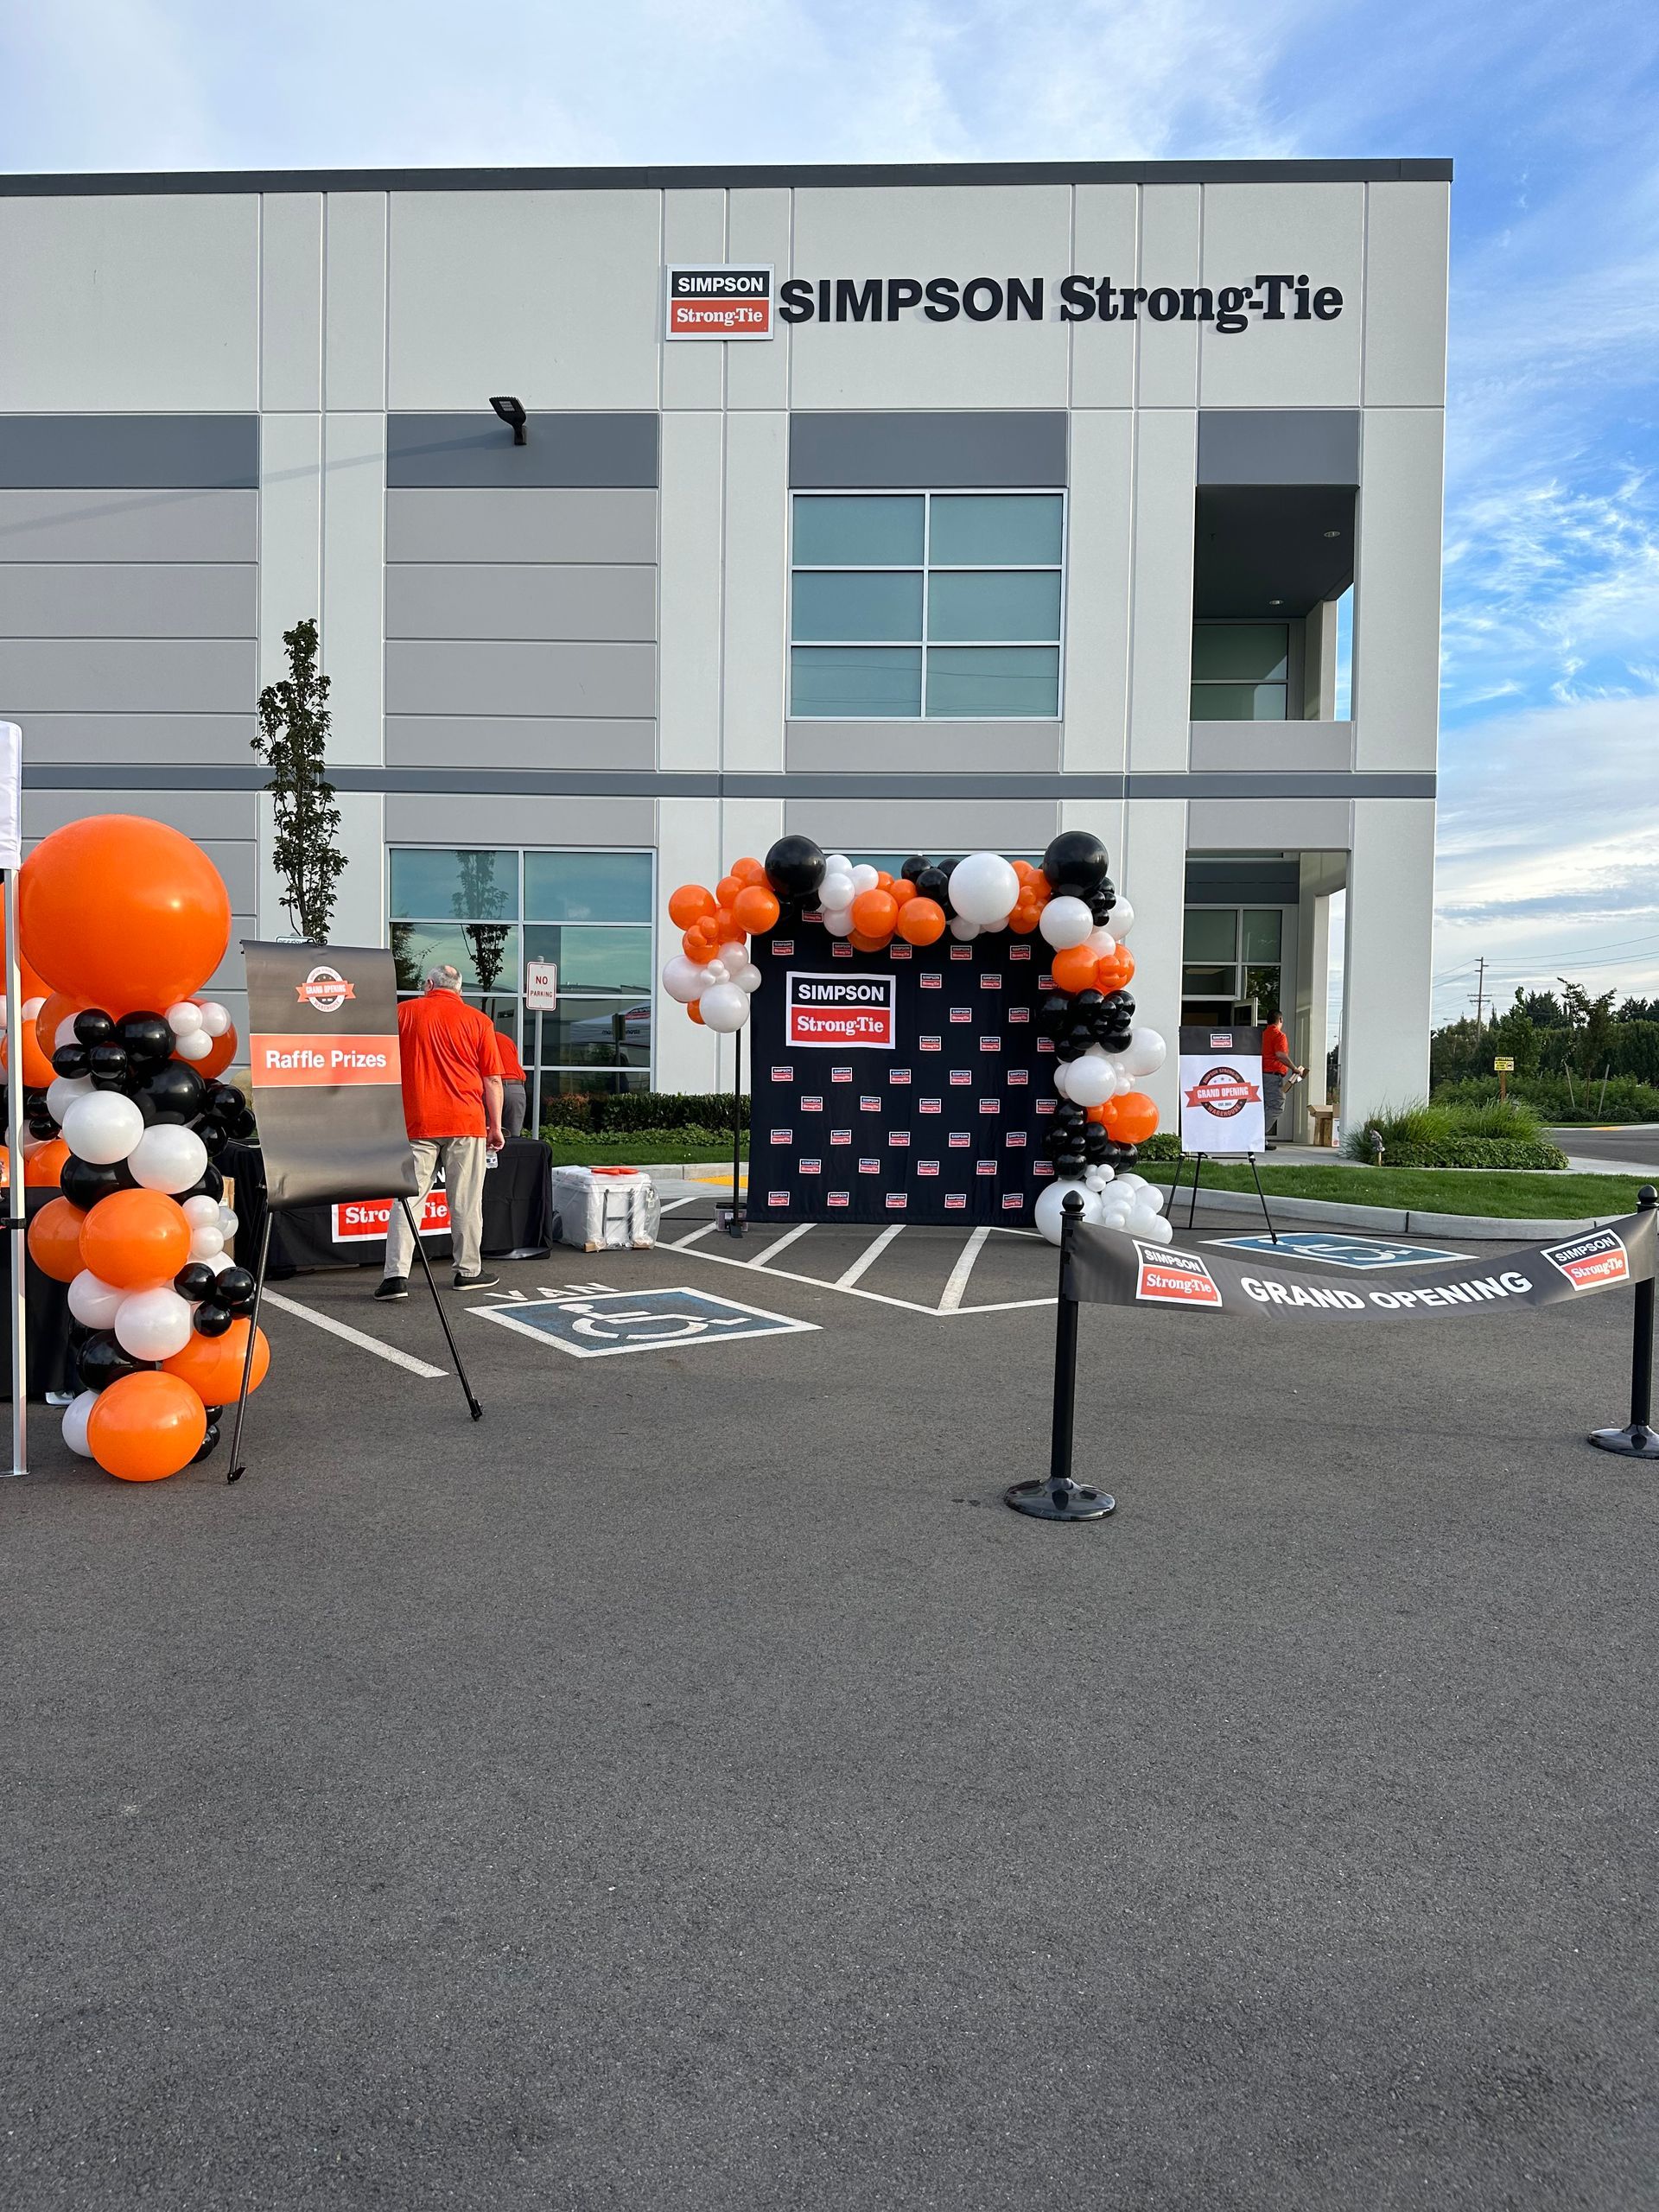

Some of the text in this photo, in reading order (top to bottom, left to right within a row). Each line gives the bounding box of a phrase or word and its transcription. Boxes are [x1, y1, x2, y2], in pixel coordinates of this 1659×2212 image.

[678, 277, 763, 292] SIMPSON
[779, 274, 1344, 334] SIMPSON Strong-Tie
[677, 308, 763, 326] Strong-Tie
[536, 976, 549, 985] NO
[798, 984, 884, 1001] SIMPSON
[798, 1015, 884, 1036] Strong-Tie
[266, 1050, 387, 1069] Raffle Prizes
[1197, 1086, 1249, 1099] GRAND OPENING
[1207, 1104, 1242, 1116] WAREHOUSE
[1554, 1236, 1615, 1263] SIMPSON
[1144, 1249, 1202, 1272] SIMPSON
[1571, 1257, 1624, 1280] Strong-Tie
[483, 1282, 621, 1301] VAN
[1147, 1274, 1211, 1294] Strong-Tie
[1241, 1272, 1535, 1309] GRAND OPENING
